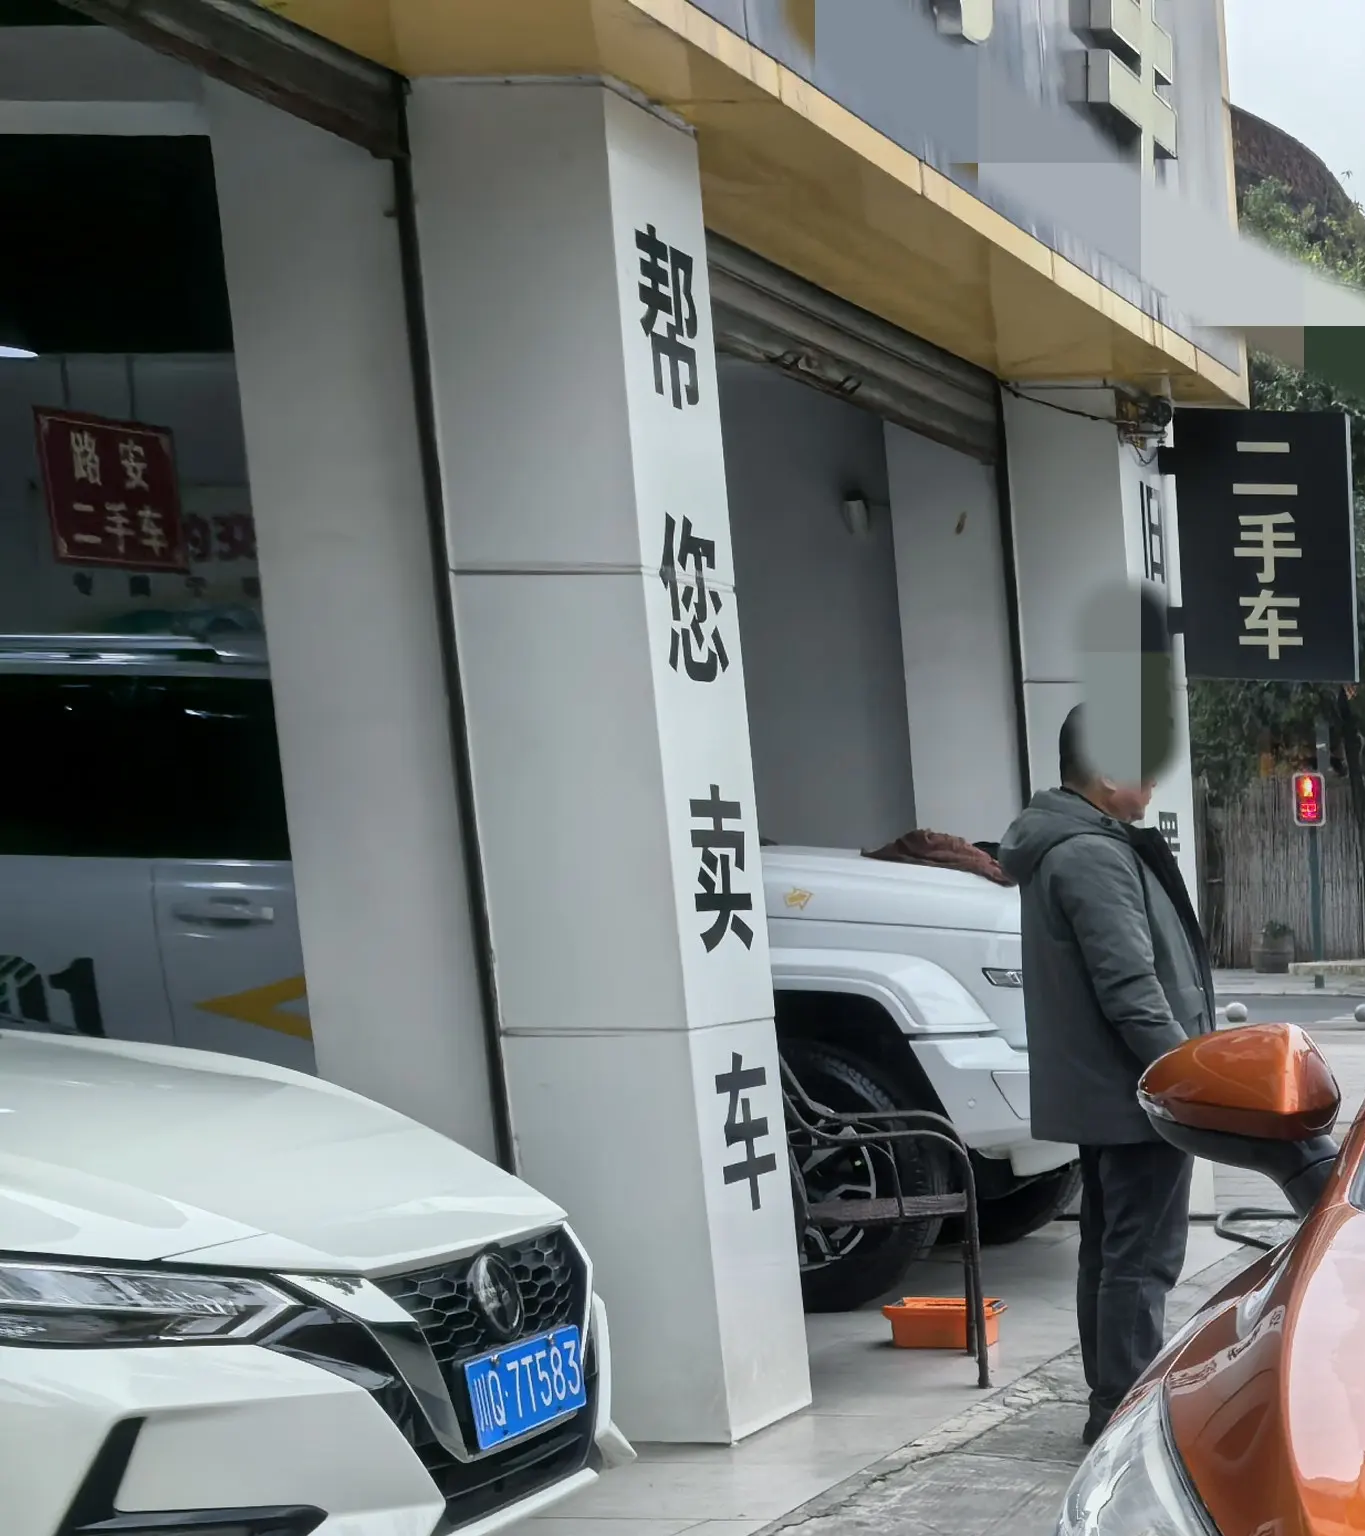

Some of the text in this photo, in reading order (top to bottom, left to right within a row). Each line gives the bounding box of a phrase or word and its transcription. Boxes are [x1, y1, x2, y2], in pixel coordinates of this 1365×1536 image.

[73, 502, 168, 556] 二手车
[1232, 441, 1304, 660] 二手车
[634, 224, 777, 1211] 帮您卖车
